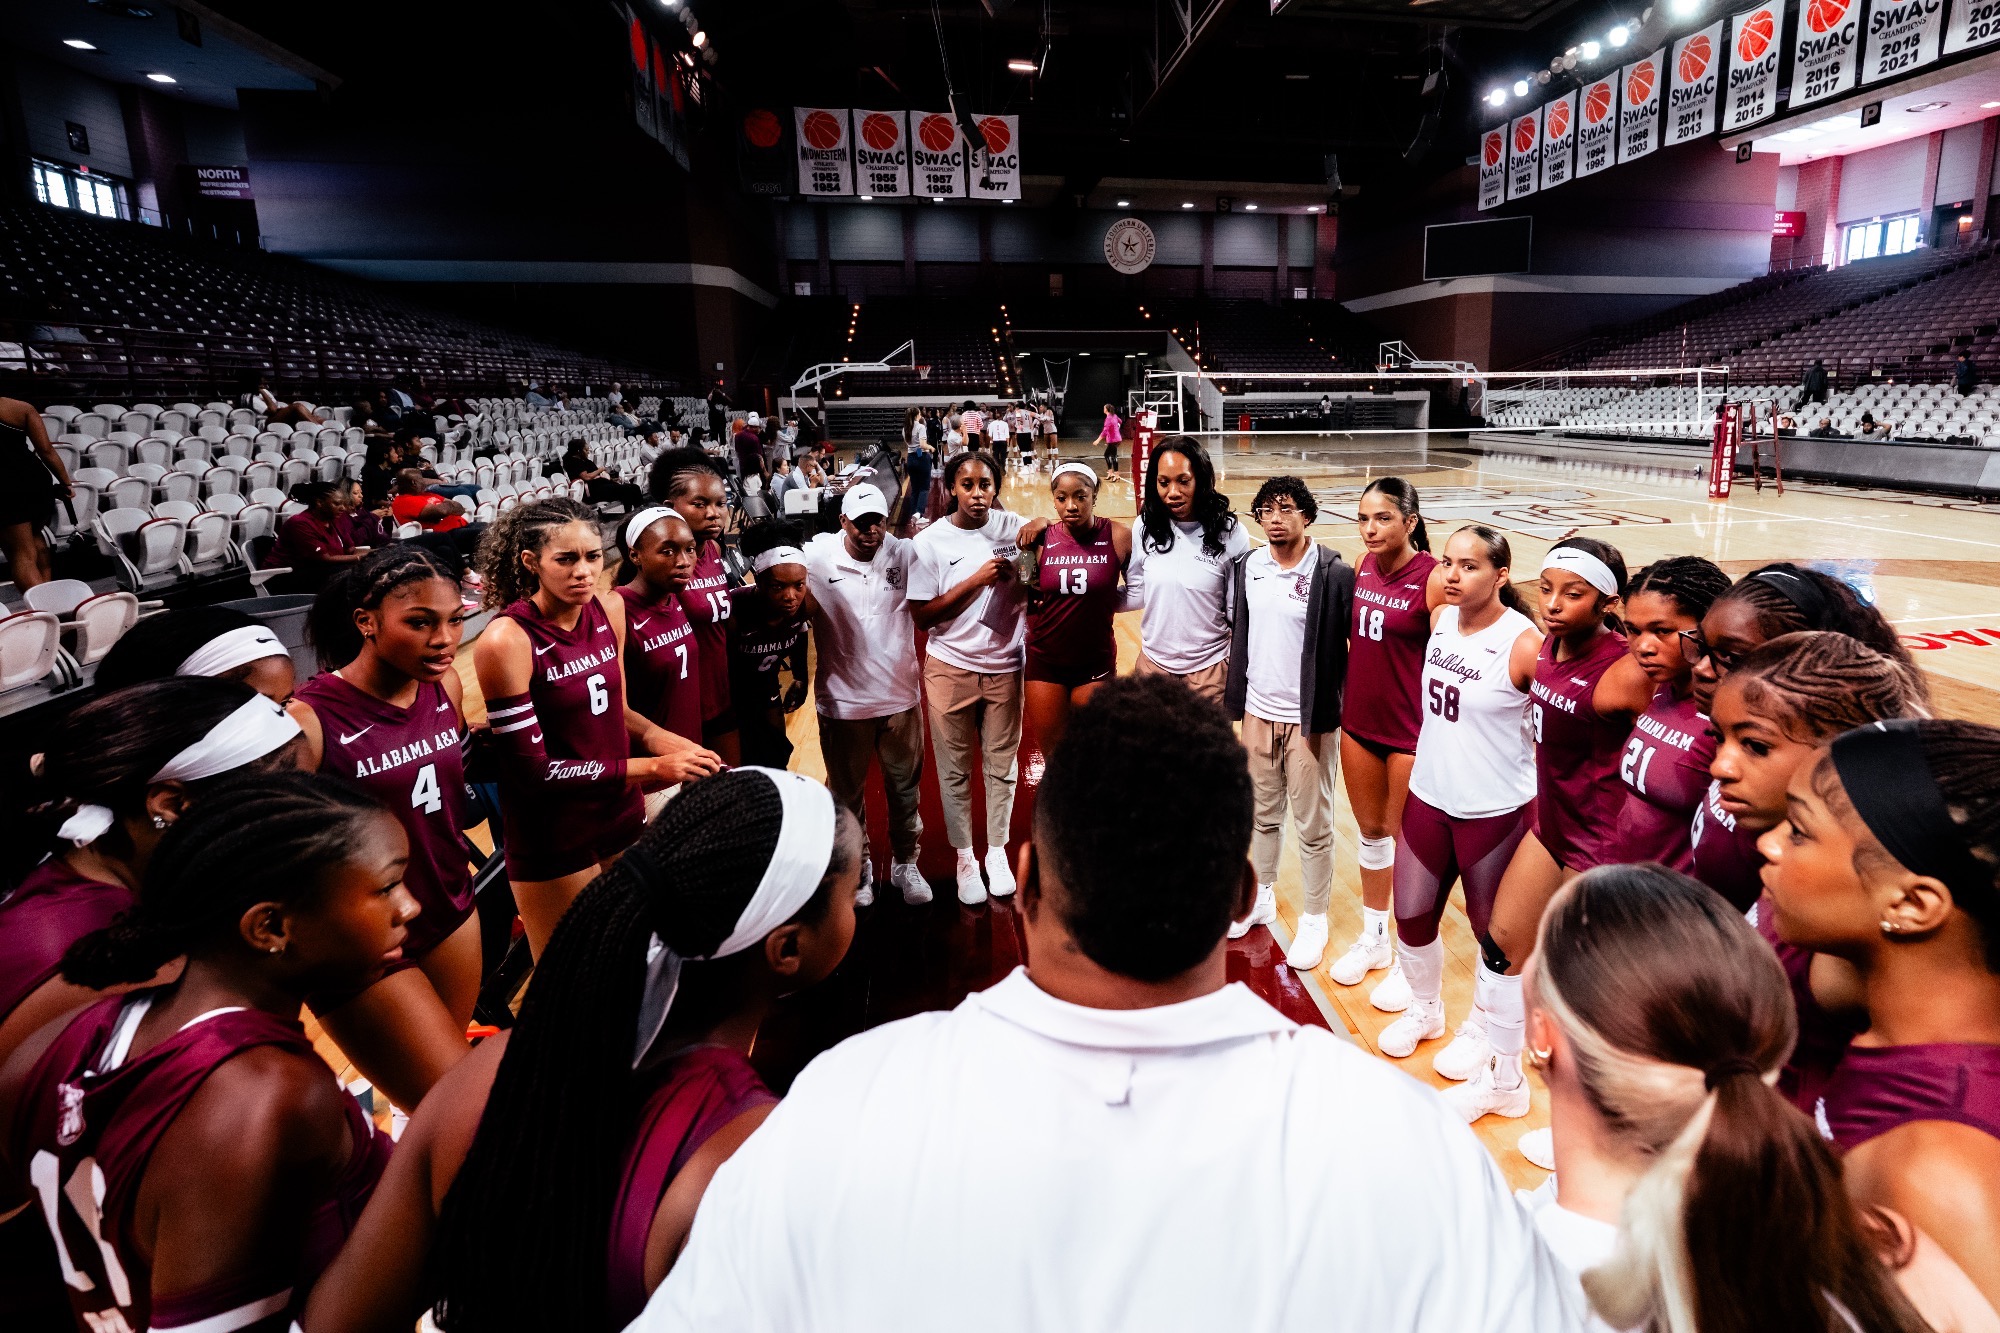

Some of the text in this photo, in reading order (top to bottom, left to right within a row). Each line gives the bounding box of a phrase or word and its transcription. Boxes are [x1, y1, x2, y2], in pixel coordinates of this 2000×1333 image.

[1870, 0, 1939, 34] SWAC
[1969, 1, 2000, 24] 202
[1878, 17, 1927, 40] CHAMPIONS
[1966, 18, 2000, 42] 202
[1798, 22, 1855, 63] SWAC
[1880, 33, 1921, 58] 2018
[1804, 47, 1846, 68] CHAMPIONS
[1877, 49, 1919, 75] 2021
[1730, 52, 1777, 89] SWAC
[1805, 61, 1841, 84] 2016
[1671, 75, 1715, 107] SWAC
[1736, 76, 1768, 94] CHAMPIONS
[1804, 78, 1840, 99] 2017
[1677, 97, 1708, 112] CHAMPIONS
[1736, 88, 1765, 109] 2014
[1623, 98, 1659, 128] SWAC
[1677, 109, 1703, 127] 2011
[1734, 103, 1764, 124] 2015
[1864, 105, 1879, 125] P
[1580, 117, 1614, 145] SWAC
[1625, 118, 1652, 133] CHAMPIONS
[1677, 122, 1702, 139] 2013
[1544, 133, 1573, 158] SWAC
[1628, 129, 1649, 144] 1998
[801, 146, 847, 161] MIDWESTERN
[858, 149, 906, 165] SWAC
[914, 150, 961, 167] SWAC
[1586, 145, 1606, 160] 1994
[1627, 141, 1648, 156] 2003
[1511, 149, 1538, 170] SWAC
[1548, 160, 1565, 173] 1990
[1585, 156, 1605, 171] 1995
[197, 169, 240, 179] NORTH
[812, 172, 840, 182] 1952
[869, 173, 897, 182] 1955
[926, 174, 953, 183] 1957
[1481, 162, 1503, 181] NAIA
[1548, 171, 1564, 183] 1992
[813, 183, 841, 192] 1954
[869, 184, 898, 192] 1956
[926, 185, 954, 193] 1958
[1485, 195, 1498, 206] 1977
[1106, 221, 1155, 267] TEXAS SOUTHERN UNIVERSITY
[1719, 421, 1736, 493] TIGERS
[1139, 432, 1151, 507] TIG
[1045, 555, 1108, 566] ALABAMA A&M
[1059, 568, 1088, 595] 13
[706, 590, 731, 623] 15
[1386, 597, 1410, 611] A&M
[1358, 605, 1385, 642] 18
[643, 628, 684, 653] ALABAMA
[738, 642, 782, 654] LABAMA
[546, 654, 599, 682] ALABAMA
[674, 644, 689, 679] 7
[1428, 648, 1482, 683] Bulldogs
[586, 673, 610, 716] 6
[1429, 678, 1460, 723] 58
[1549, 693, 1577, 714] A&M
[1662, 729, 1695, 752] A&M
[356, 739, 433, 778] ALABAMA
[1621, 737, 1657, 795] 21
[544, 758, 606, 783] Family
[411, 763, 442, 814] 4
